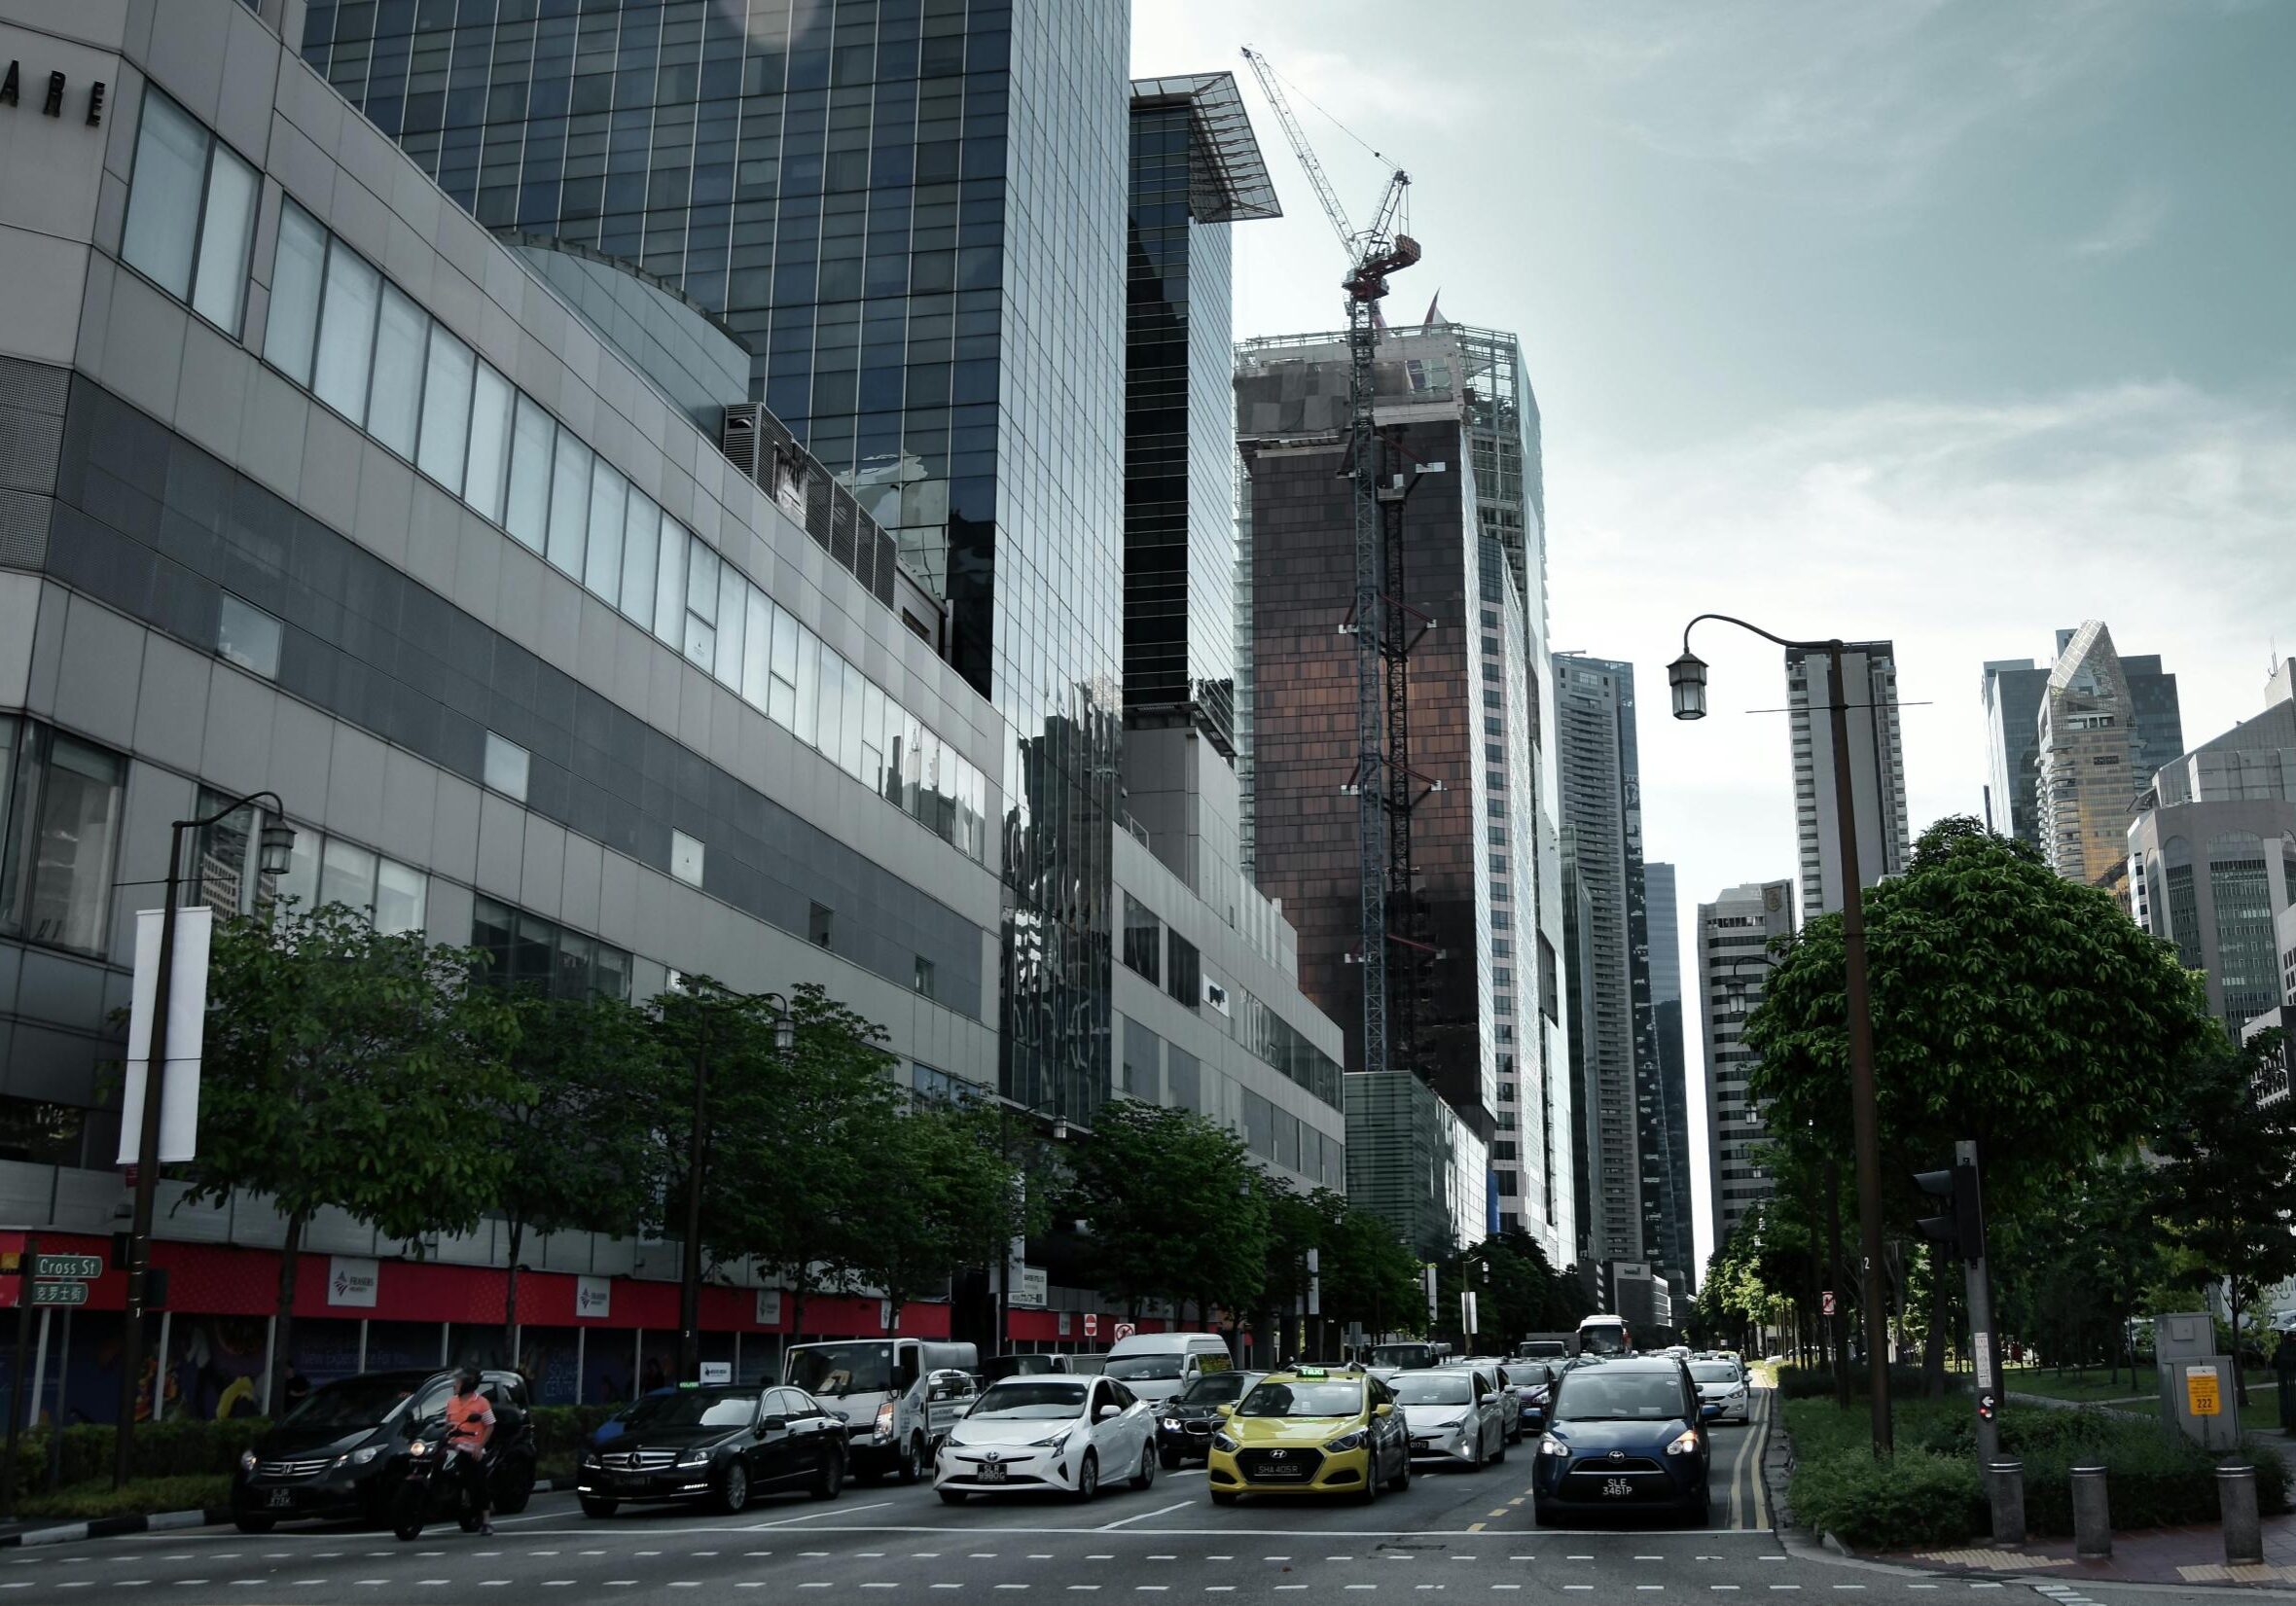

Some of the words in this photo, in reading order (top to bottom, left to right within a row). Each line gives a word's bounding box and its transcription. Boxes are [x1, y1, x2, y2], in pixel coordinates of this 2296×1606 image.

[40, 1258, 77, 1274] Cross
[81, 1259, 95, 1275] St
[1864, 1257, 1870, 1269] 2
[2197, 1398, 2212, 1409] 222
[1607, 1478, 1627, 1486] SLE
